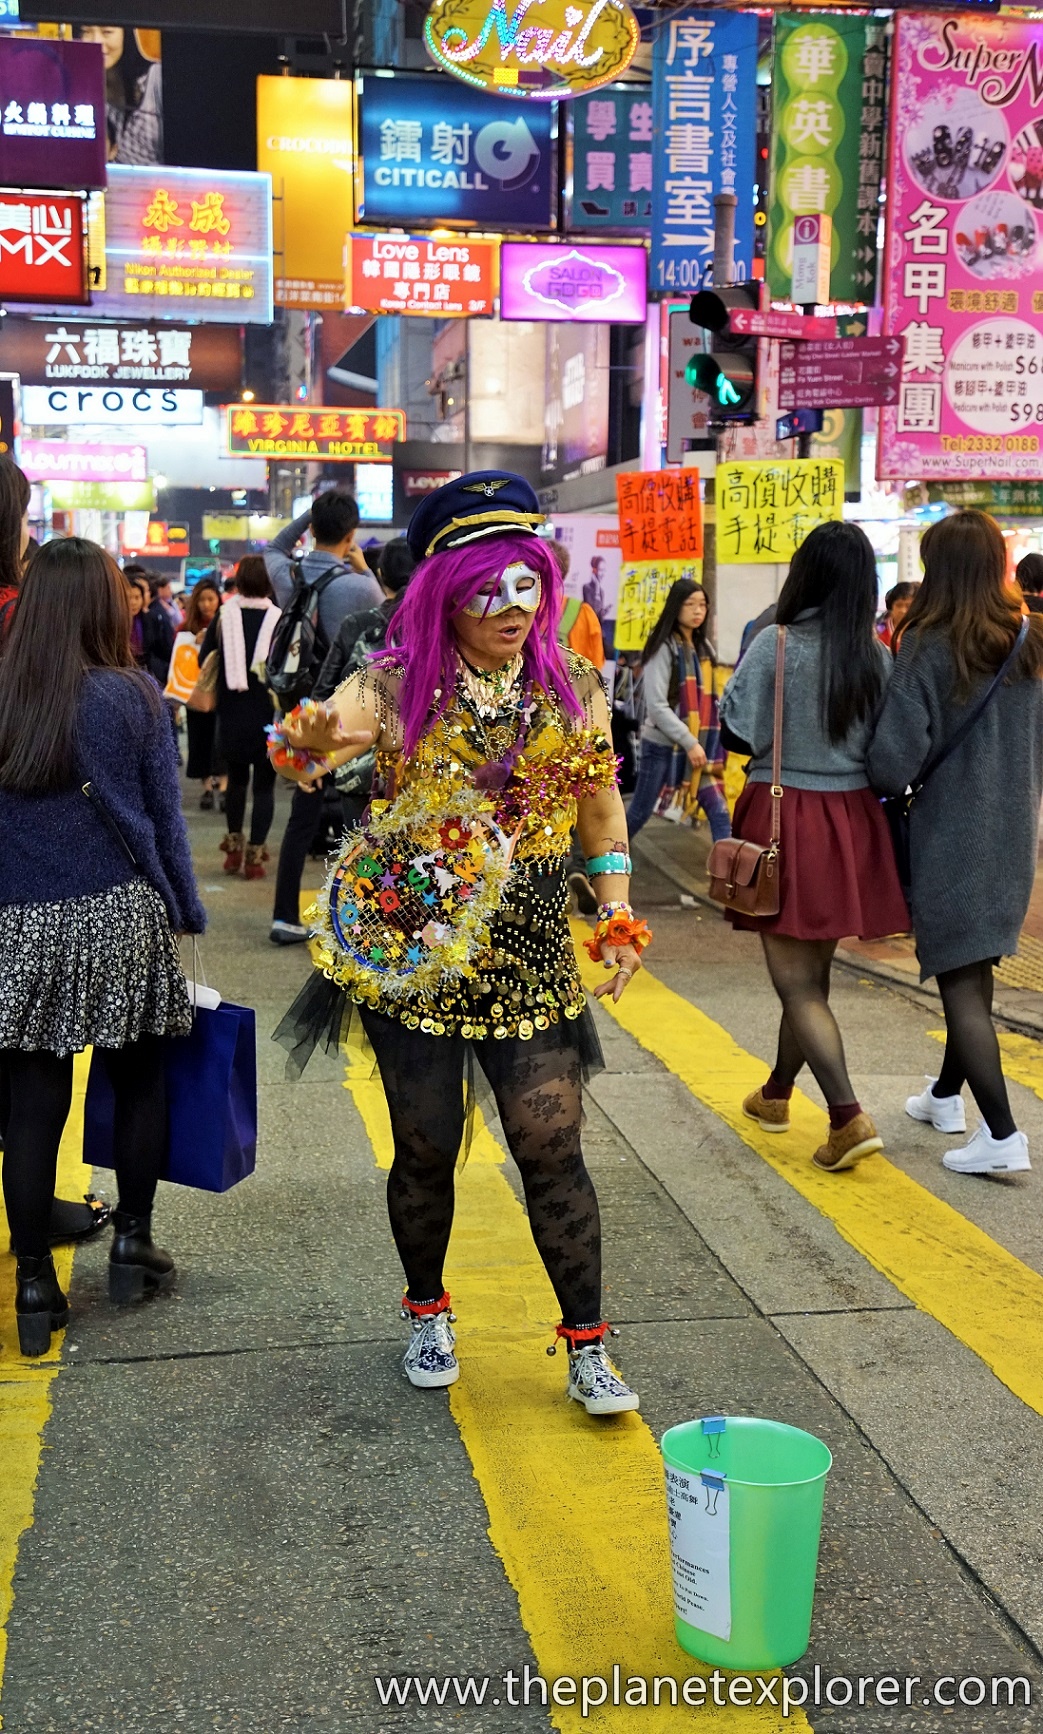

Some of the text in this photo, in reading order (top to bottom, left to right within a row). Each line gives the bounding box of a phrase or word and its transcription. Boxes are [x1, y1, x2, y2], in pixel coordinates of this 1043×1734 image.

[441, 0, 604, 66] Nail
[664, 16, 716, 225] 序言書室
[379, 118, 473, 165] 鐳射
[787, 35, 837, 270] 華英書
[374, 167, 489, 190] CITICALL
[373, 241, 470, 262] Love Lens
[550, 267, 602, 282] SALON
[806, 263, 817, 283] Kok
[393, 281, 451, 300] 專門店
[897, 200, 949, 433] 名甲集團
[45, 327, 192, 366] 六福珠寶
[45, 364, 192, 380] LUKFOOK JEWELLERY
[1016, 355, 1043, 374] $6
[824, 374, 843, 382] Street
[48, 390, 178, 412] crocs
[248, 439, 382, 455] VIRGINIA HOTEL
[1006, 439, 1038, 452] 0188
[621, 474, 694, 514] 高價收購
[721, 466, 839, 510] 高價收購
